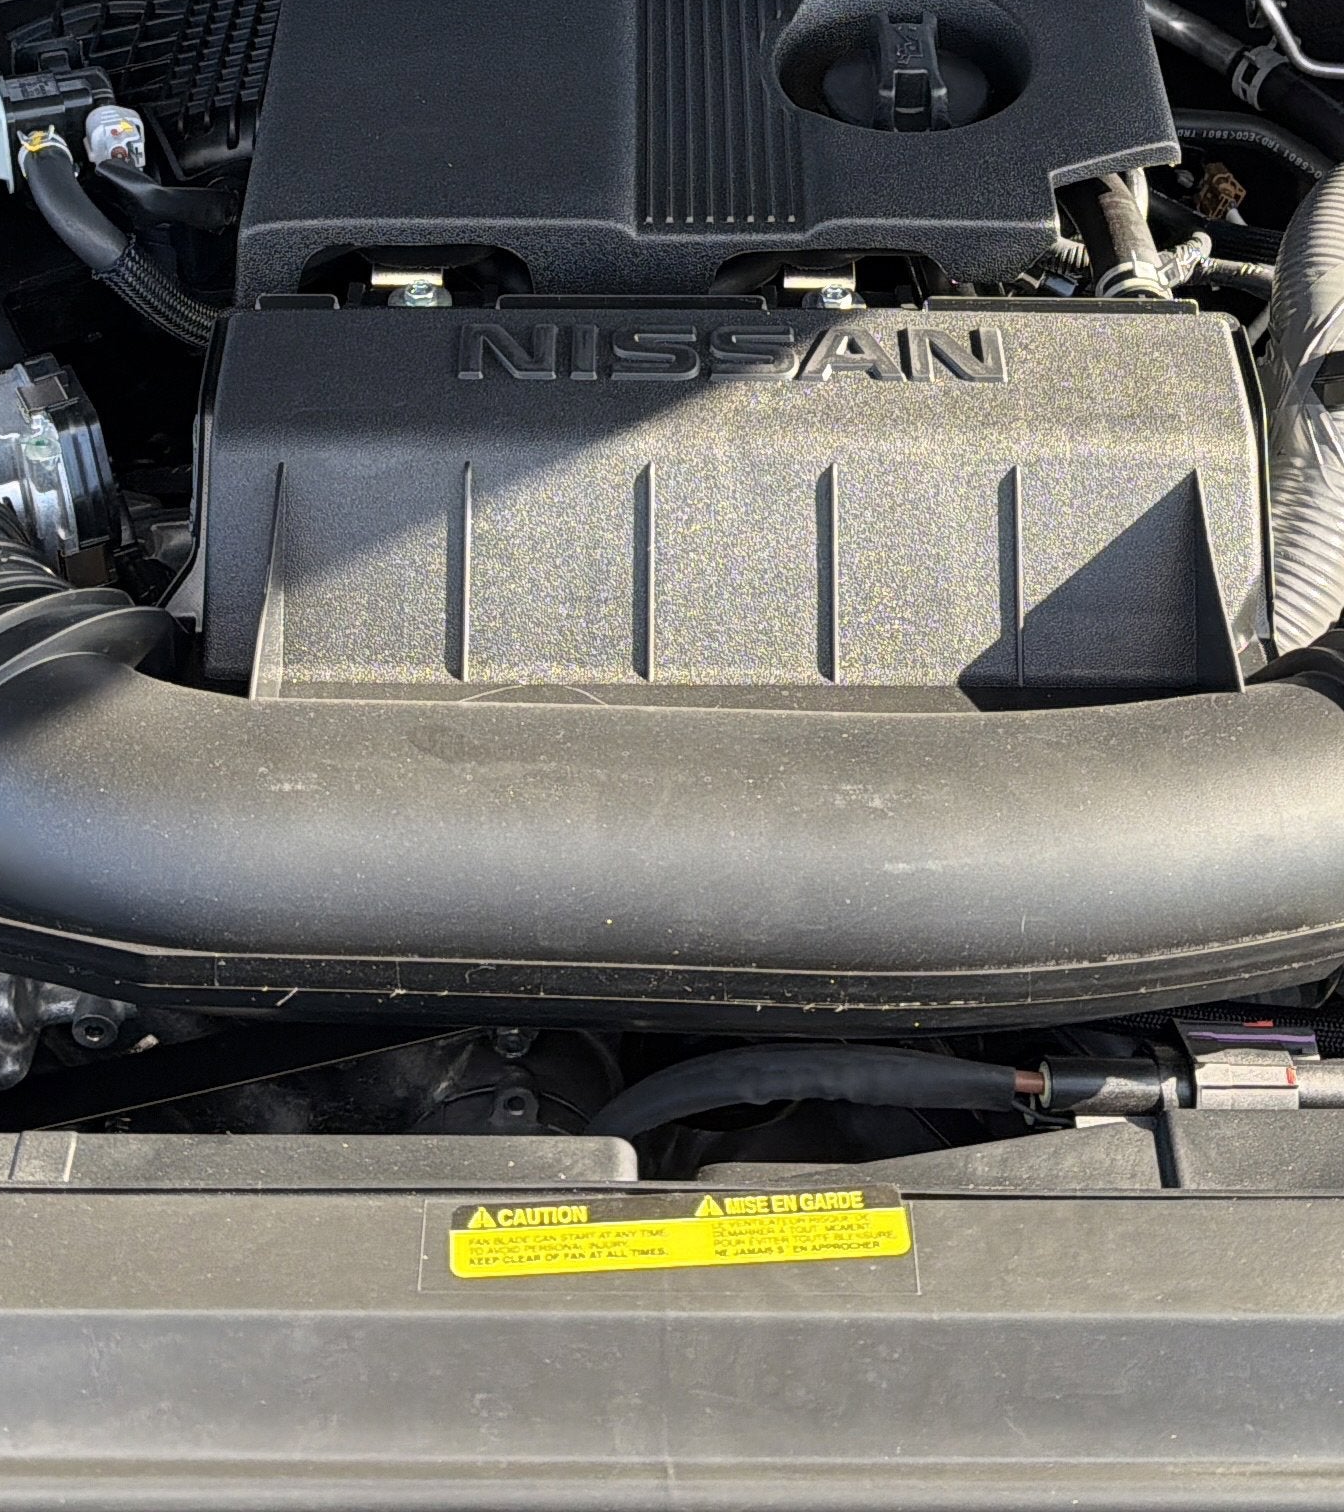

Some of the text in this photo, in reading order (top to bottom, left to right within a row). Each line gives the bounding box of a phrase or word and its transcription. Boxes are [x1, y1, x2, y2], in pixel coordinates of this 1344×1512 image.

[457, 324, 1010, 383] NISSAN
[724, 1190, 865, 1215] MISE EN GARDE
[497, 1205, 588, 1227] CAUTION
[468, 1256, 502, 1267] KEEP
[502, 1254, 542, 1265] CLEAR
[544, 1252, 560, 1262] OF
[563, 1251, 587, 1261] FAN
[589, 1250, 603, 1259] AT
[605, 1249, 628, 1259] ALL
